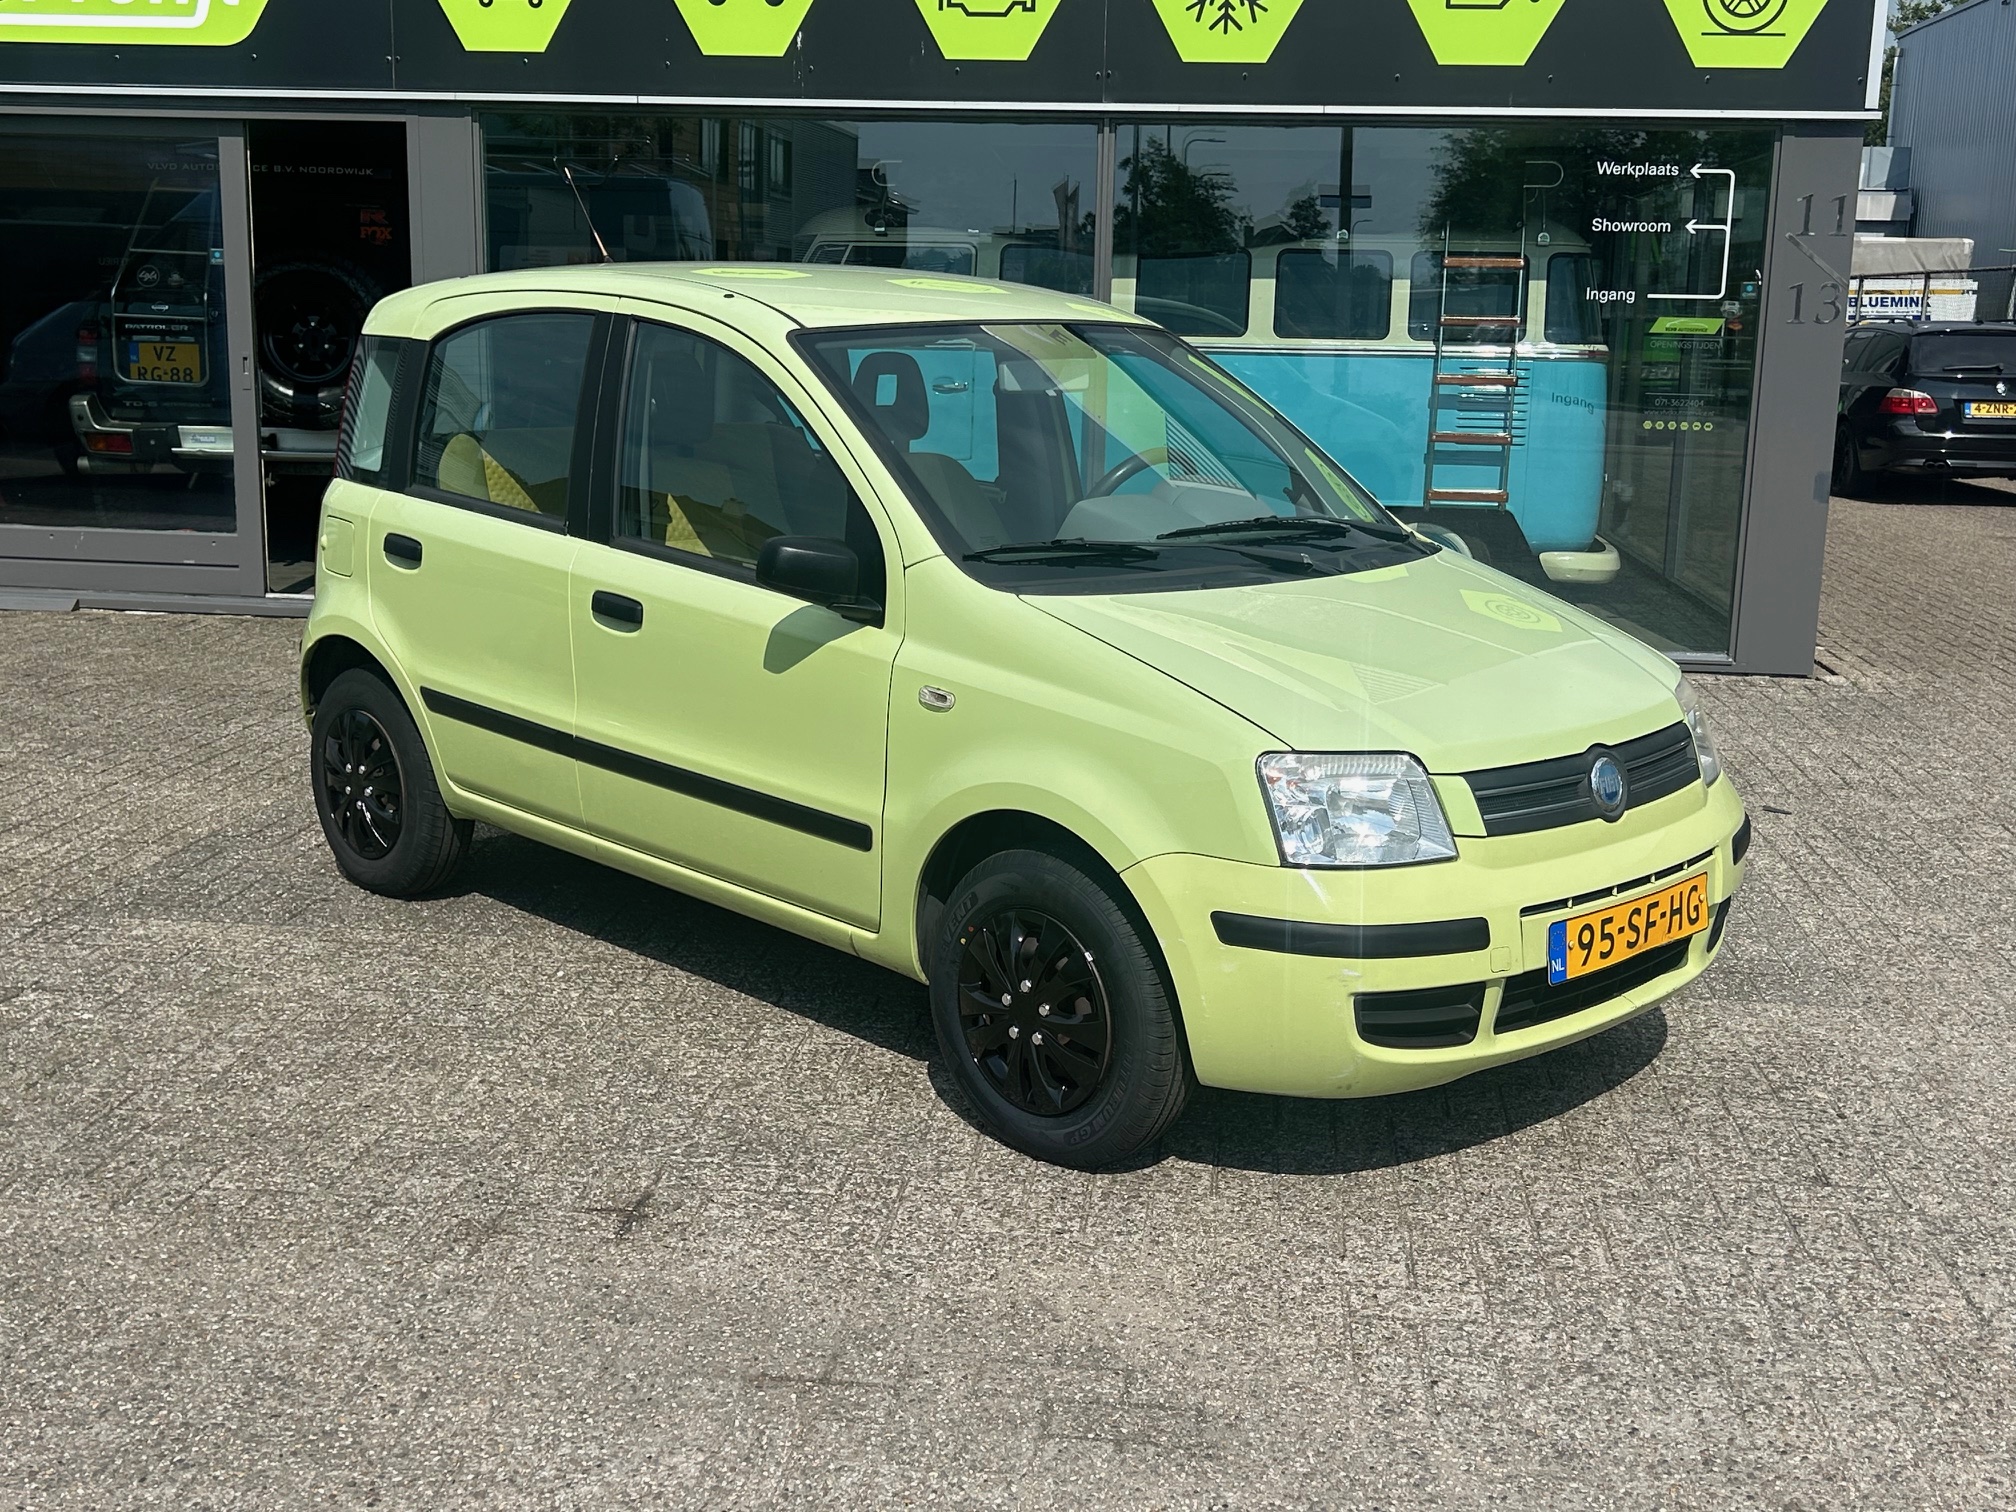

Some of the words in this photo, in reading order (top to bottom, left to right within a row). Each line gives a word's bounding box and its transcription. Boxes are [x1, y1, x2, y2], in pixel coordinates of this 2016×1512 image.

[299, 166, 374, 176] NOORDWIJK
[1596, 161, 1680, 180] Werkplaats
[1796, 193, 1848, 237] 11
[1591, 218, 1672, 233] Showroom
[1586, 287, 1636, 304] Ingang
[1785, 281, 1842, 325] 13
[153, 345, 177, 362] VZ
[1649, 340, 1722, 350] OPENINGSTIJDEN
[137, 366, 194, 383] RG-88
[1550, 391, 1596, 416] Ingang
[1577, 884, 1700, 967] 95-SF-HG
[1551, 960, 1565, 973] NL
